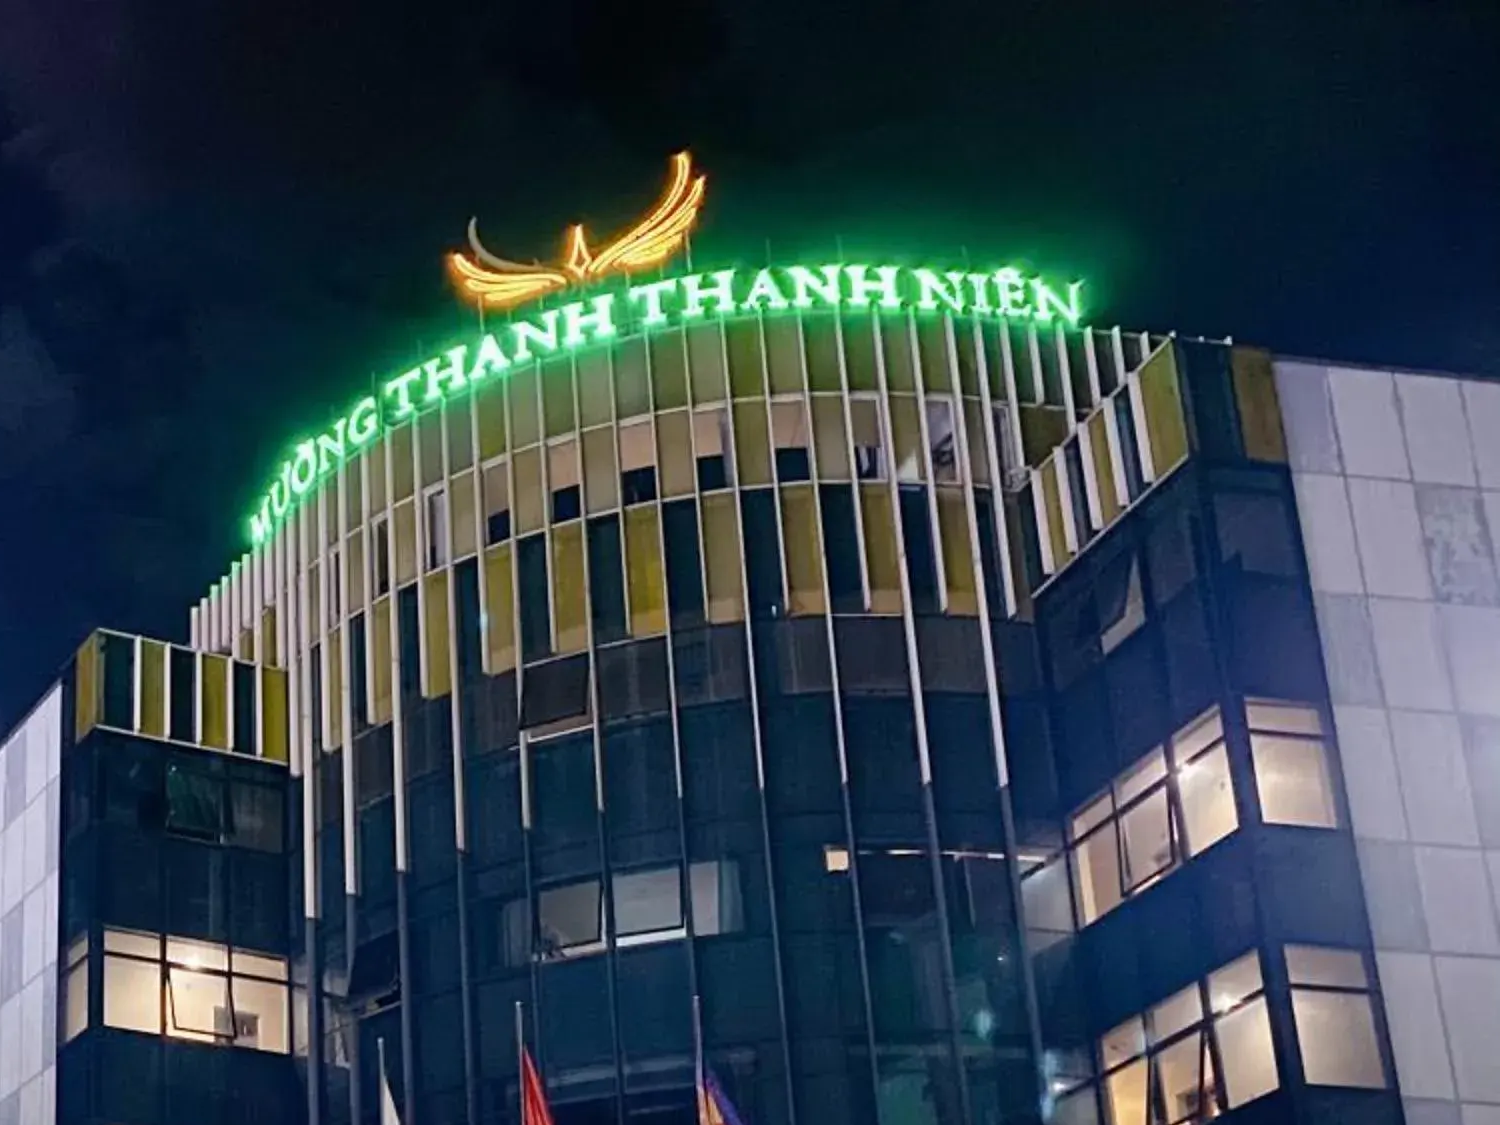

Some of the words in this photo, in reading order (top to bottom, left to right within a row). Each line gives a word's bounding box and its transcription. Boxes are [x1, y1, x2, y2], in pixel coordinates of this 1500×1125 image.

[384, 293, 615, 418] THANH
[628, 264, 903, 326] THANH
[911, 266, 1086, 327] NIÊN
